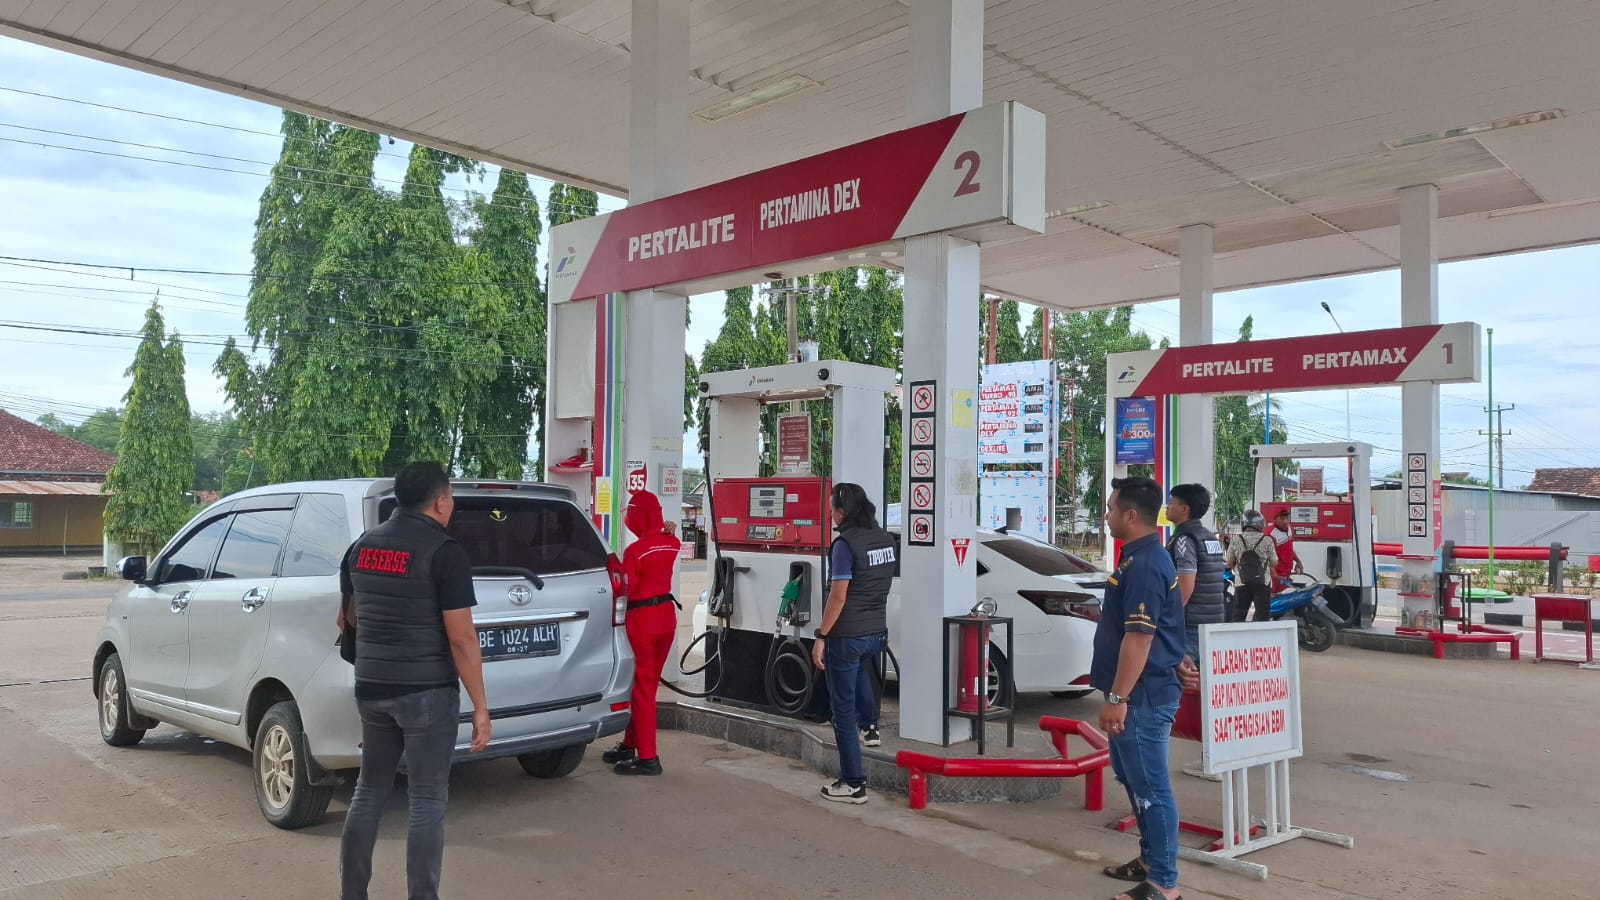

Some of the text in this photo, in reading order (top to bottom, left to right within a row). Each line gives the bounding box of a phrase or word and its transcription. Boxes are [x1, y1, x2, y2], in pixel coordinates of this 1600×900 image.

[953, 150, 981, 198] 2
[760, 177, 861, 230] PERTAMINA DEX
[628, 213, 735, 262] PERTALITE
[1182, 346, 1407, 378] PERTALITE PERTAMAX
[1441, 342, 1454, 365] 1
[627, 473, 645, 491] 135
[356, 547, 411, 576] RESERSE
[480, 630, 495, 648] BE
[500, 628, 529, 646] 1024
[1212, 646, 1282, 675] DILARANG MEROKOK
[1225, 681, 1247, 708] MATIKAN
[1247, 680, 1262, 705] MESIN
[1263, 677, 1289, 703] KENDARAAN
[1214, 709, 1285, 743] SAAT PENGISIAN BBM
